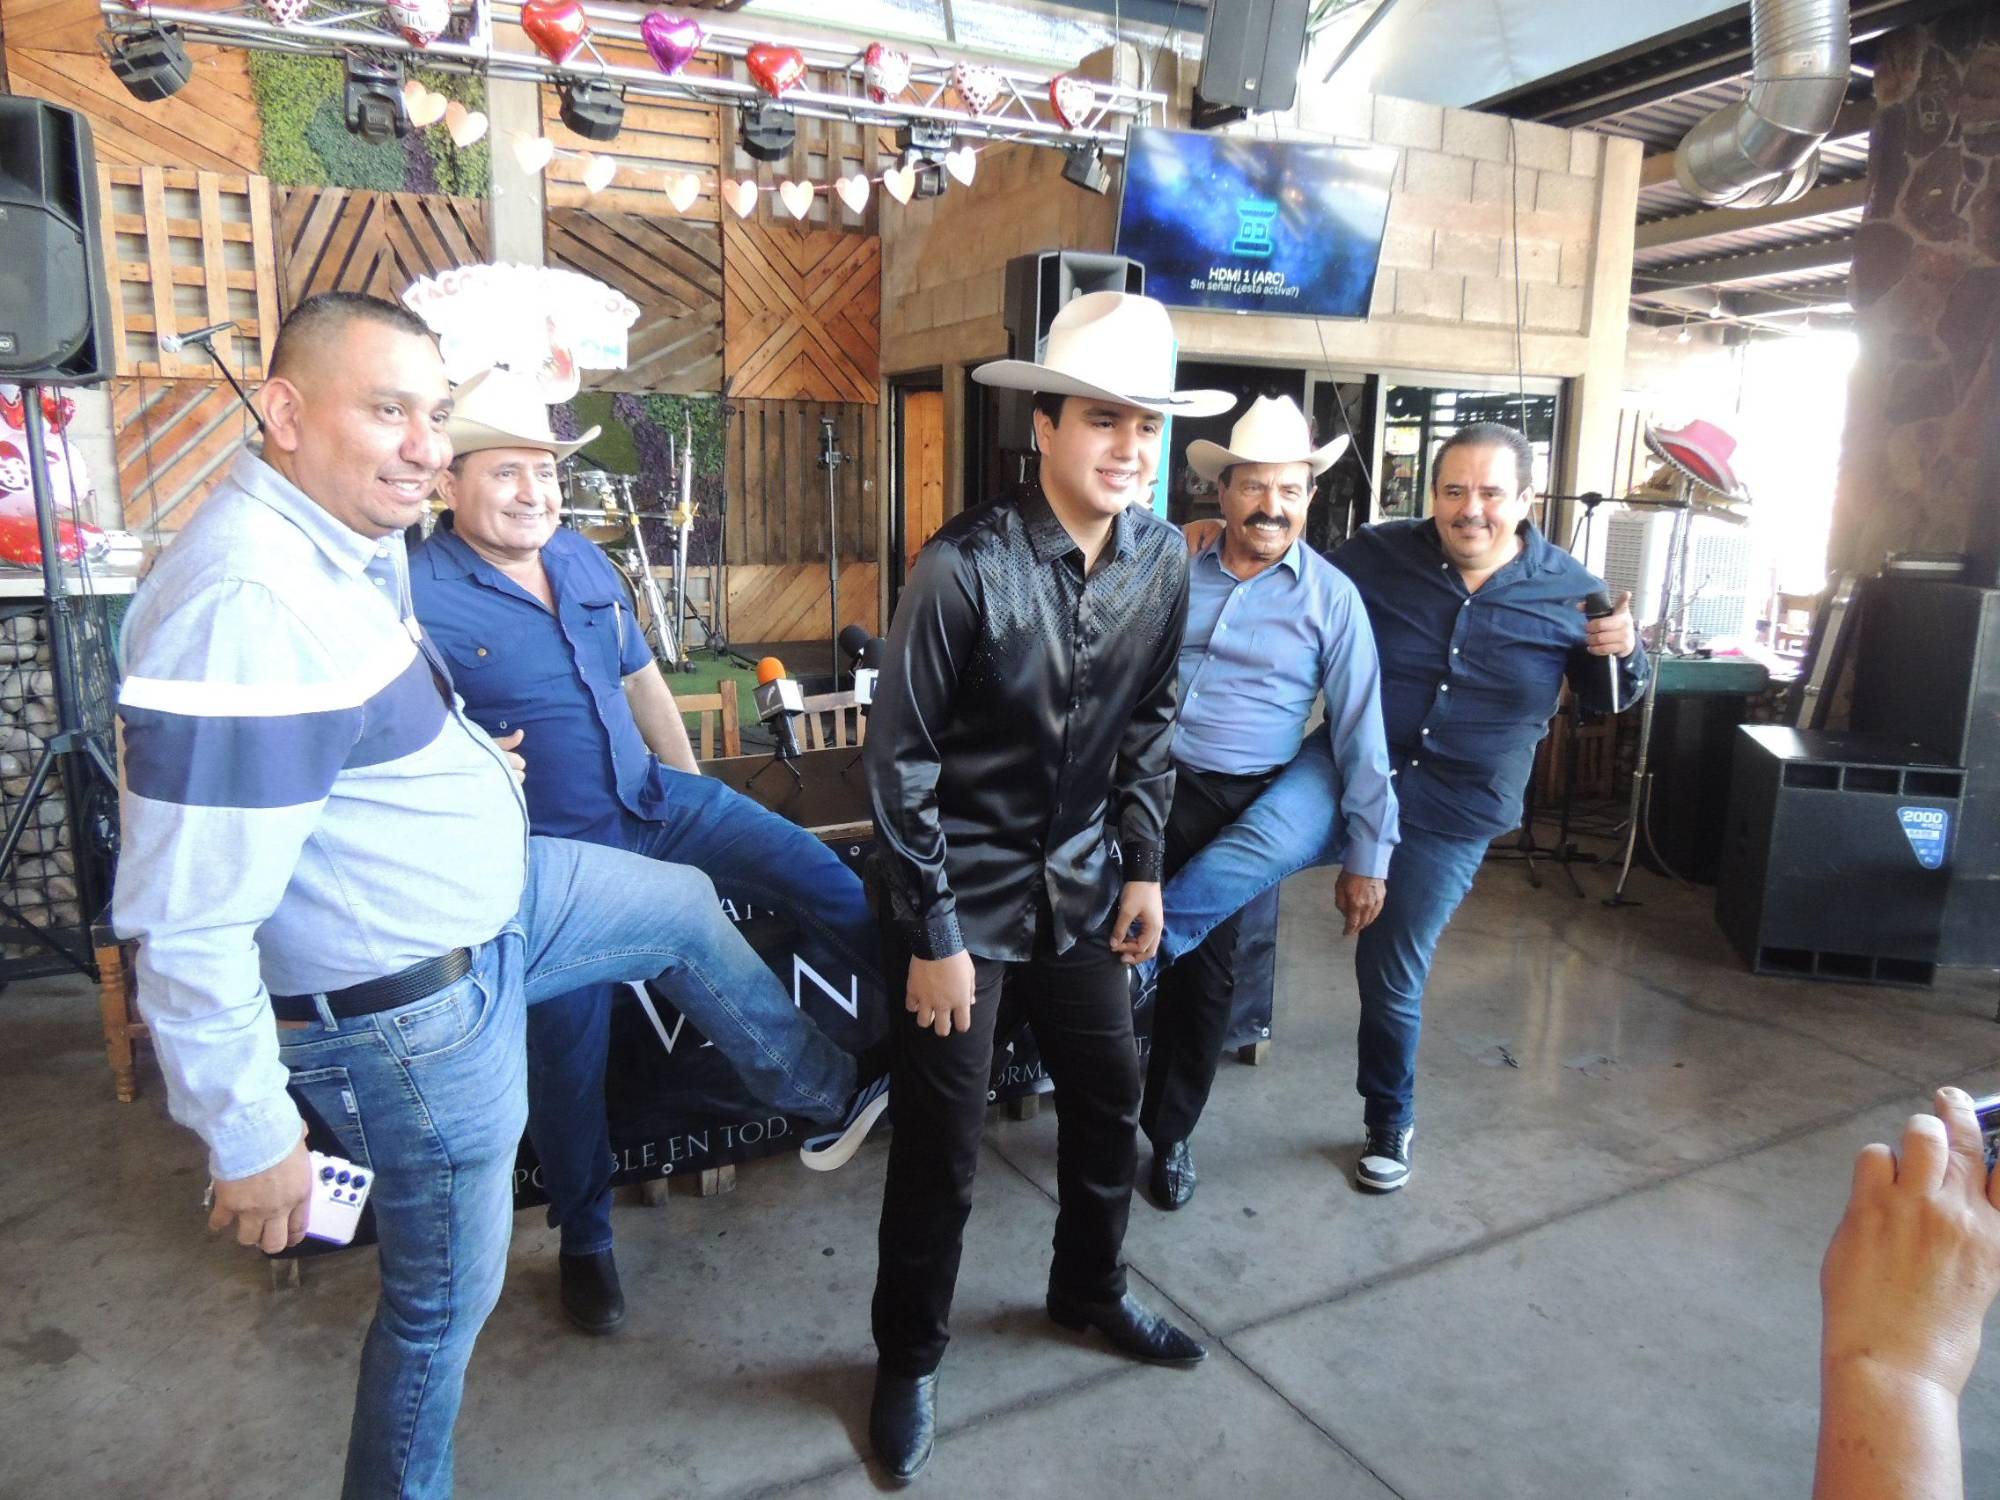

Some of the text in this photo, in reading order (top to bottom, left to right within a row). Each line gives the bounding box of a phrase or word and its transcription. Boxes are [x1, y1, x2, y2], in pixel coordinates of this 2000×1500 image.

[1190, 279, 1206, 290] Sin
[1208, 267, 1285, 287] HDMI 1 (ARC)
[1903, 810, 1943, 824] 2000
[669, 1131, 708, 1162] EN
[720, 1115, 793, 1148] TOD
